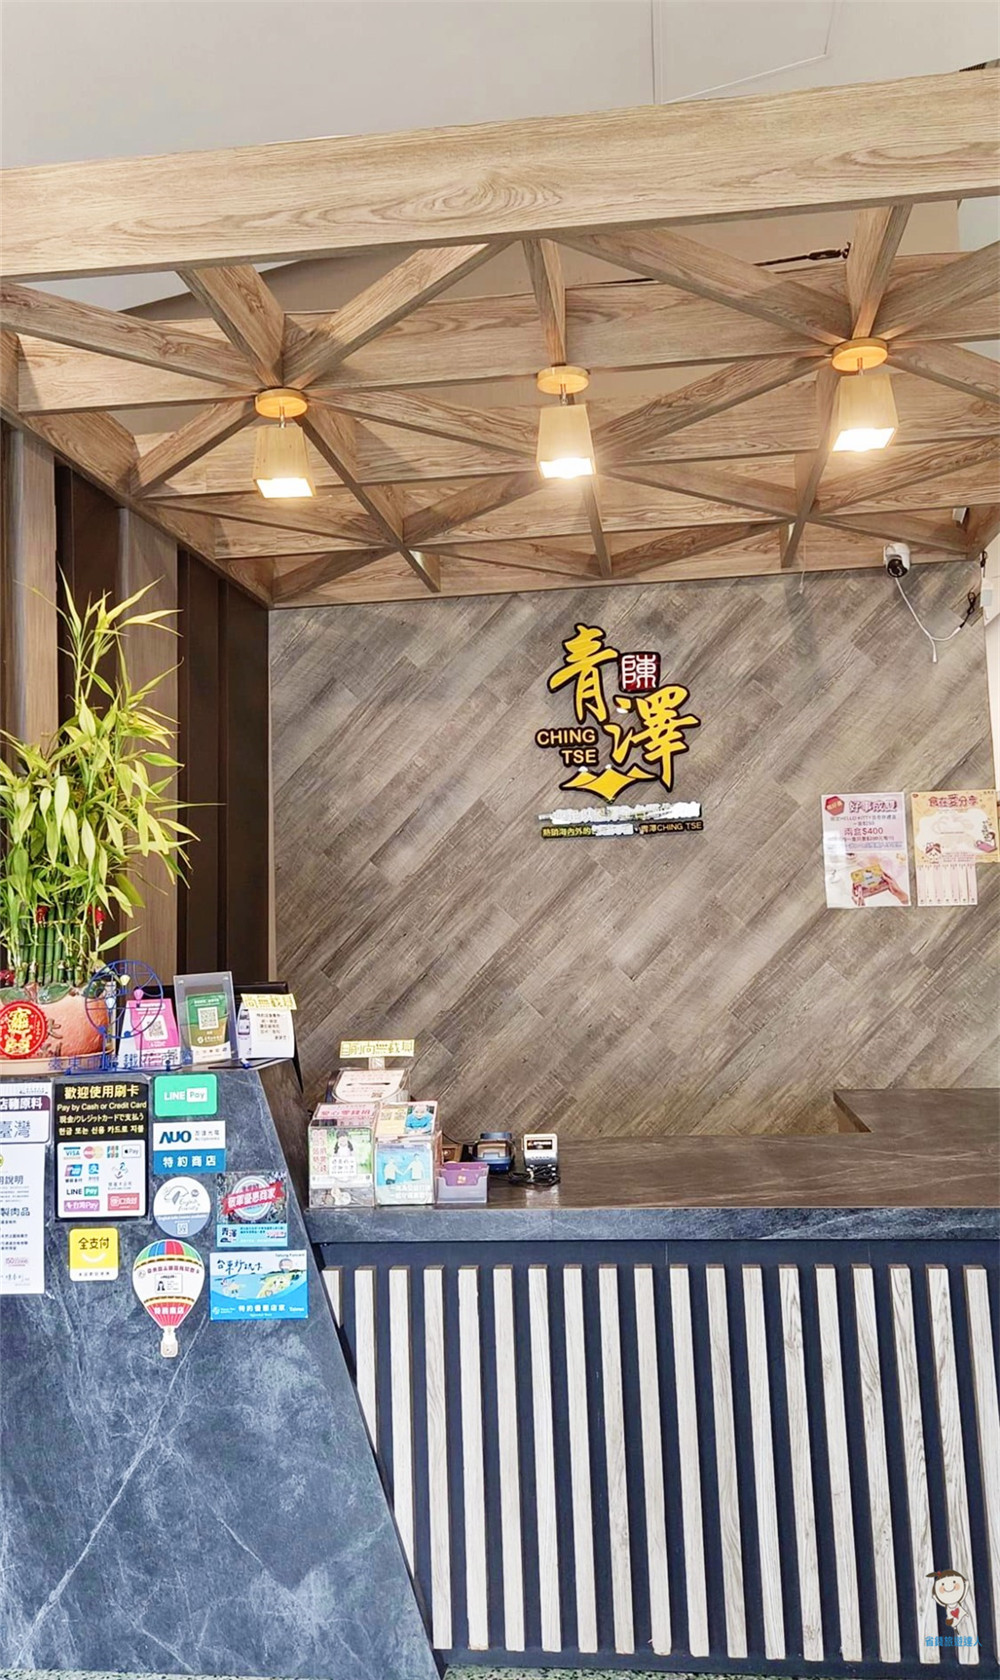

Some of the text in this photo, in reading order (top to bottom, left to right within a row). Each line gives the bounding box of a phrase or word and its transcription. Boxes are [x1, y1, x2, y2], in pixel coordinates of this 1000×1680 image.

[536, 729, 596, 745] CHING
[562, 749, 597, 764] TSE
[685, 821, 702, 830] TSE
[64, 1084, 140, 1100] 歡迎使用刷卡
[164, 1090, 205, 1101] LINE Pay
[57, 1103, 70, 1113] Pay
[71, 1104, 80, 1112] by
[81, 1103, 99, 1111] Cash
[108, 1102, 129, 1110] Credit
[130, 1101, 147, 1109] Card
[74, 1126, 89, 1135] 또는
[91, 1125, 105, 1135] 신용
[107, 1125, 128, 1134] 카드로
[159, 1130, 192, 1144] AUO
[163, 1155, 217, 1168] 特約商店
[78, 1237, 109, 1250] 全支付
